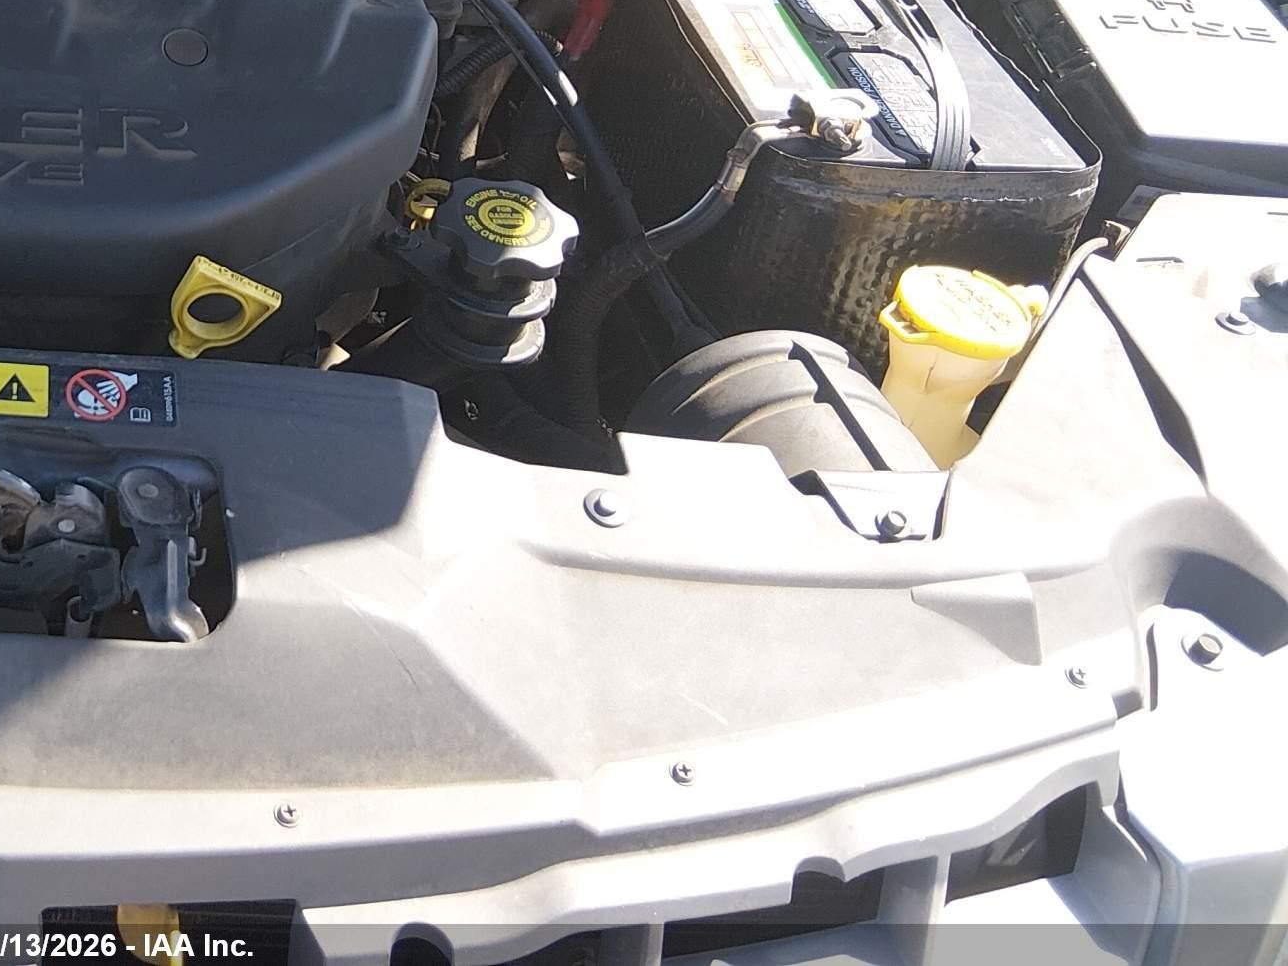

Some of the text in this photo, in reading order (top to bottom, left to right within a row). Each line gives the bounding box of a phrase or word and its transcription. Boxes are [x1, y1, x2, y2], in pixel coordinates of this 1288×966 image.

[1098, 14, 1278, 44] FUSE
[465, 189, 537, 210] ENGINE OIL
[465, 215, 482, 232] SEE
